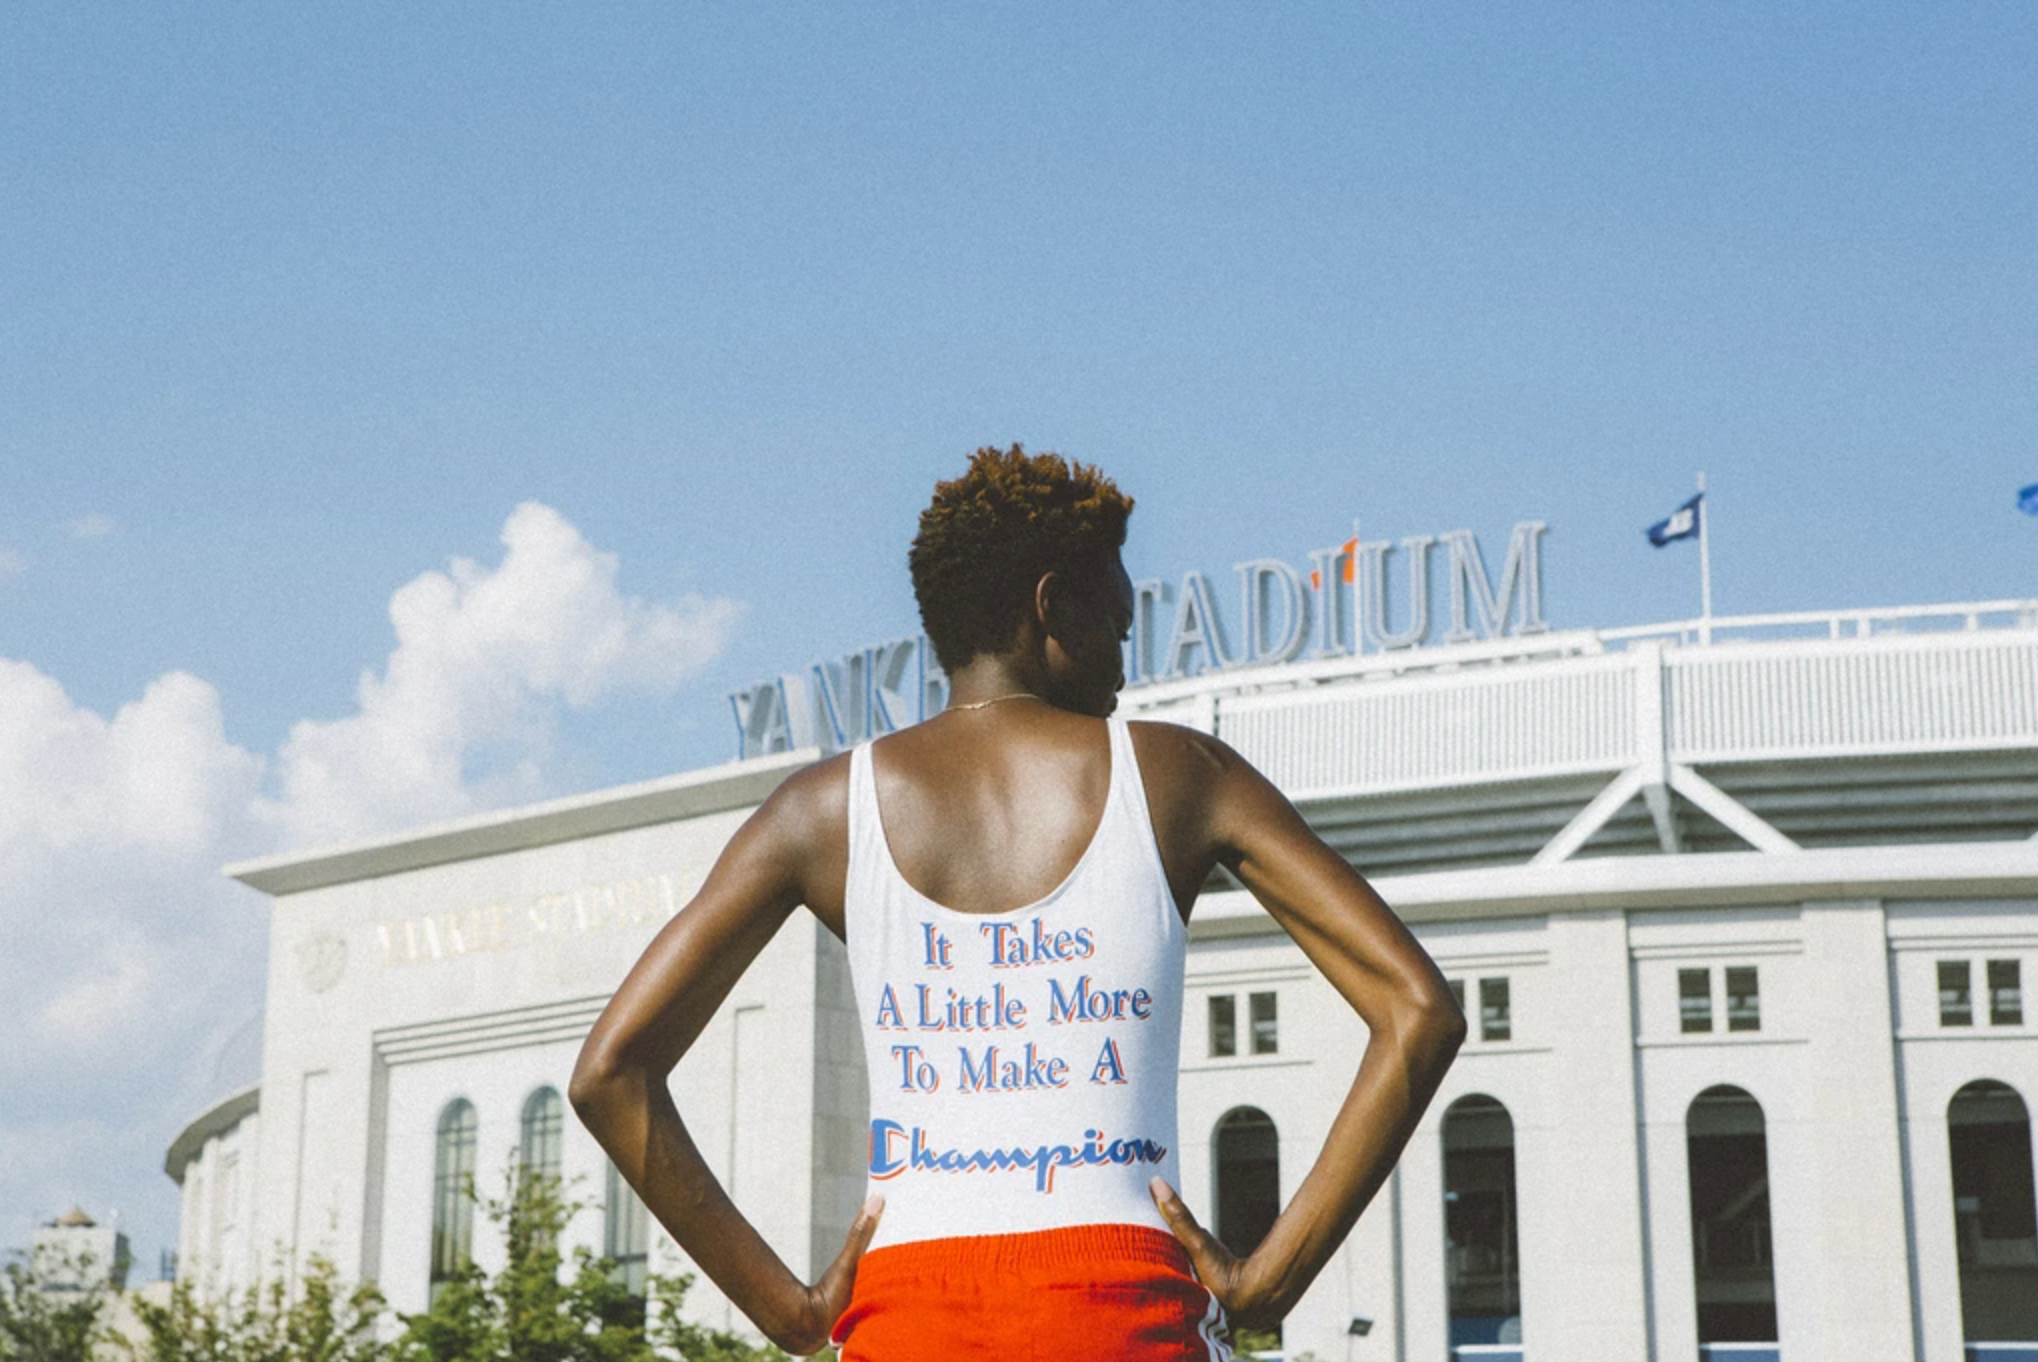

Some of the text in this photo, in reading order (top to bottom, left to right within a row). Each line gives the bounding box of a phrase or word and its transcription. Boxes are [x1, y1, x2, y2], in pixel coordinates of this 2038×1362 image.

[1126, 521, 1549, 688] TADIUM
[920, 917, 1096, 970] It Takes
[875, 974, 1152, 1033] A Little More
[891, 1036, 1128, 1094] To Make A
[868, 1118, 1167, 1194] Champion
